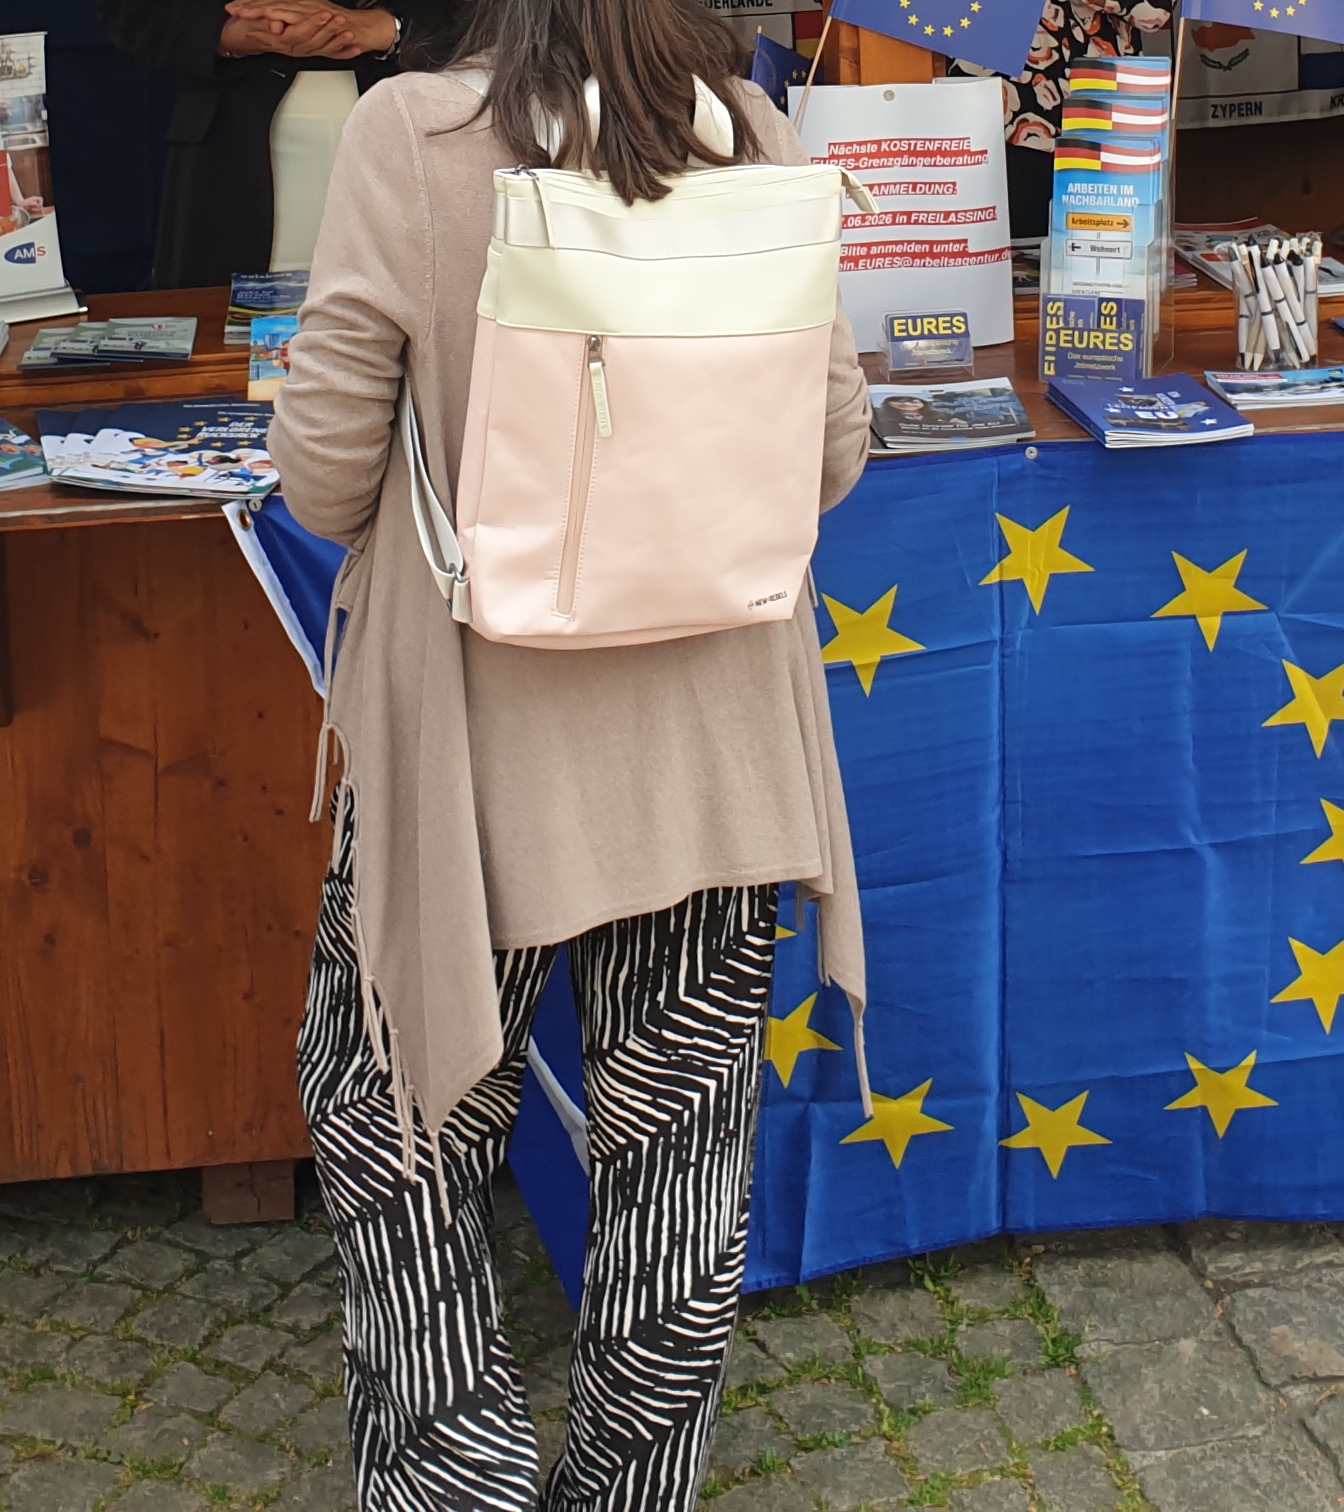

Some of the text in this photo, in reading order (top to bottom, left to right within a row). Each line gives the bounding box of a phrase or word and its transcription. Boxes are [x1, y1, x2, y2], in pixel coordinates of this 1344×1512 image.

[1211, 101, 1263, 119] ZYPERN
[829, 139, 971, 156] Nächste KOSTENFREIE
[871, 183, 957, 196] ANMELDUNG:
[1066, 183, 1134, 195] ARBEITEN IM
[1061, 194, 1139, 208] NACHBARLAND
[896, 213, 907, 224] in
[911, 208, 997, 224] FREILASSING!
[14, 246, 47, 260] AMS
[870, 242, 930, 254] anmelden
[933, 242, 969, 253] unter:
[893, 316, 967, 337] EURES
[1059, 329, 1134, 352] EURES
